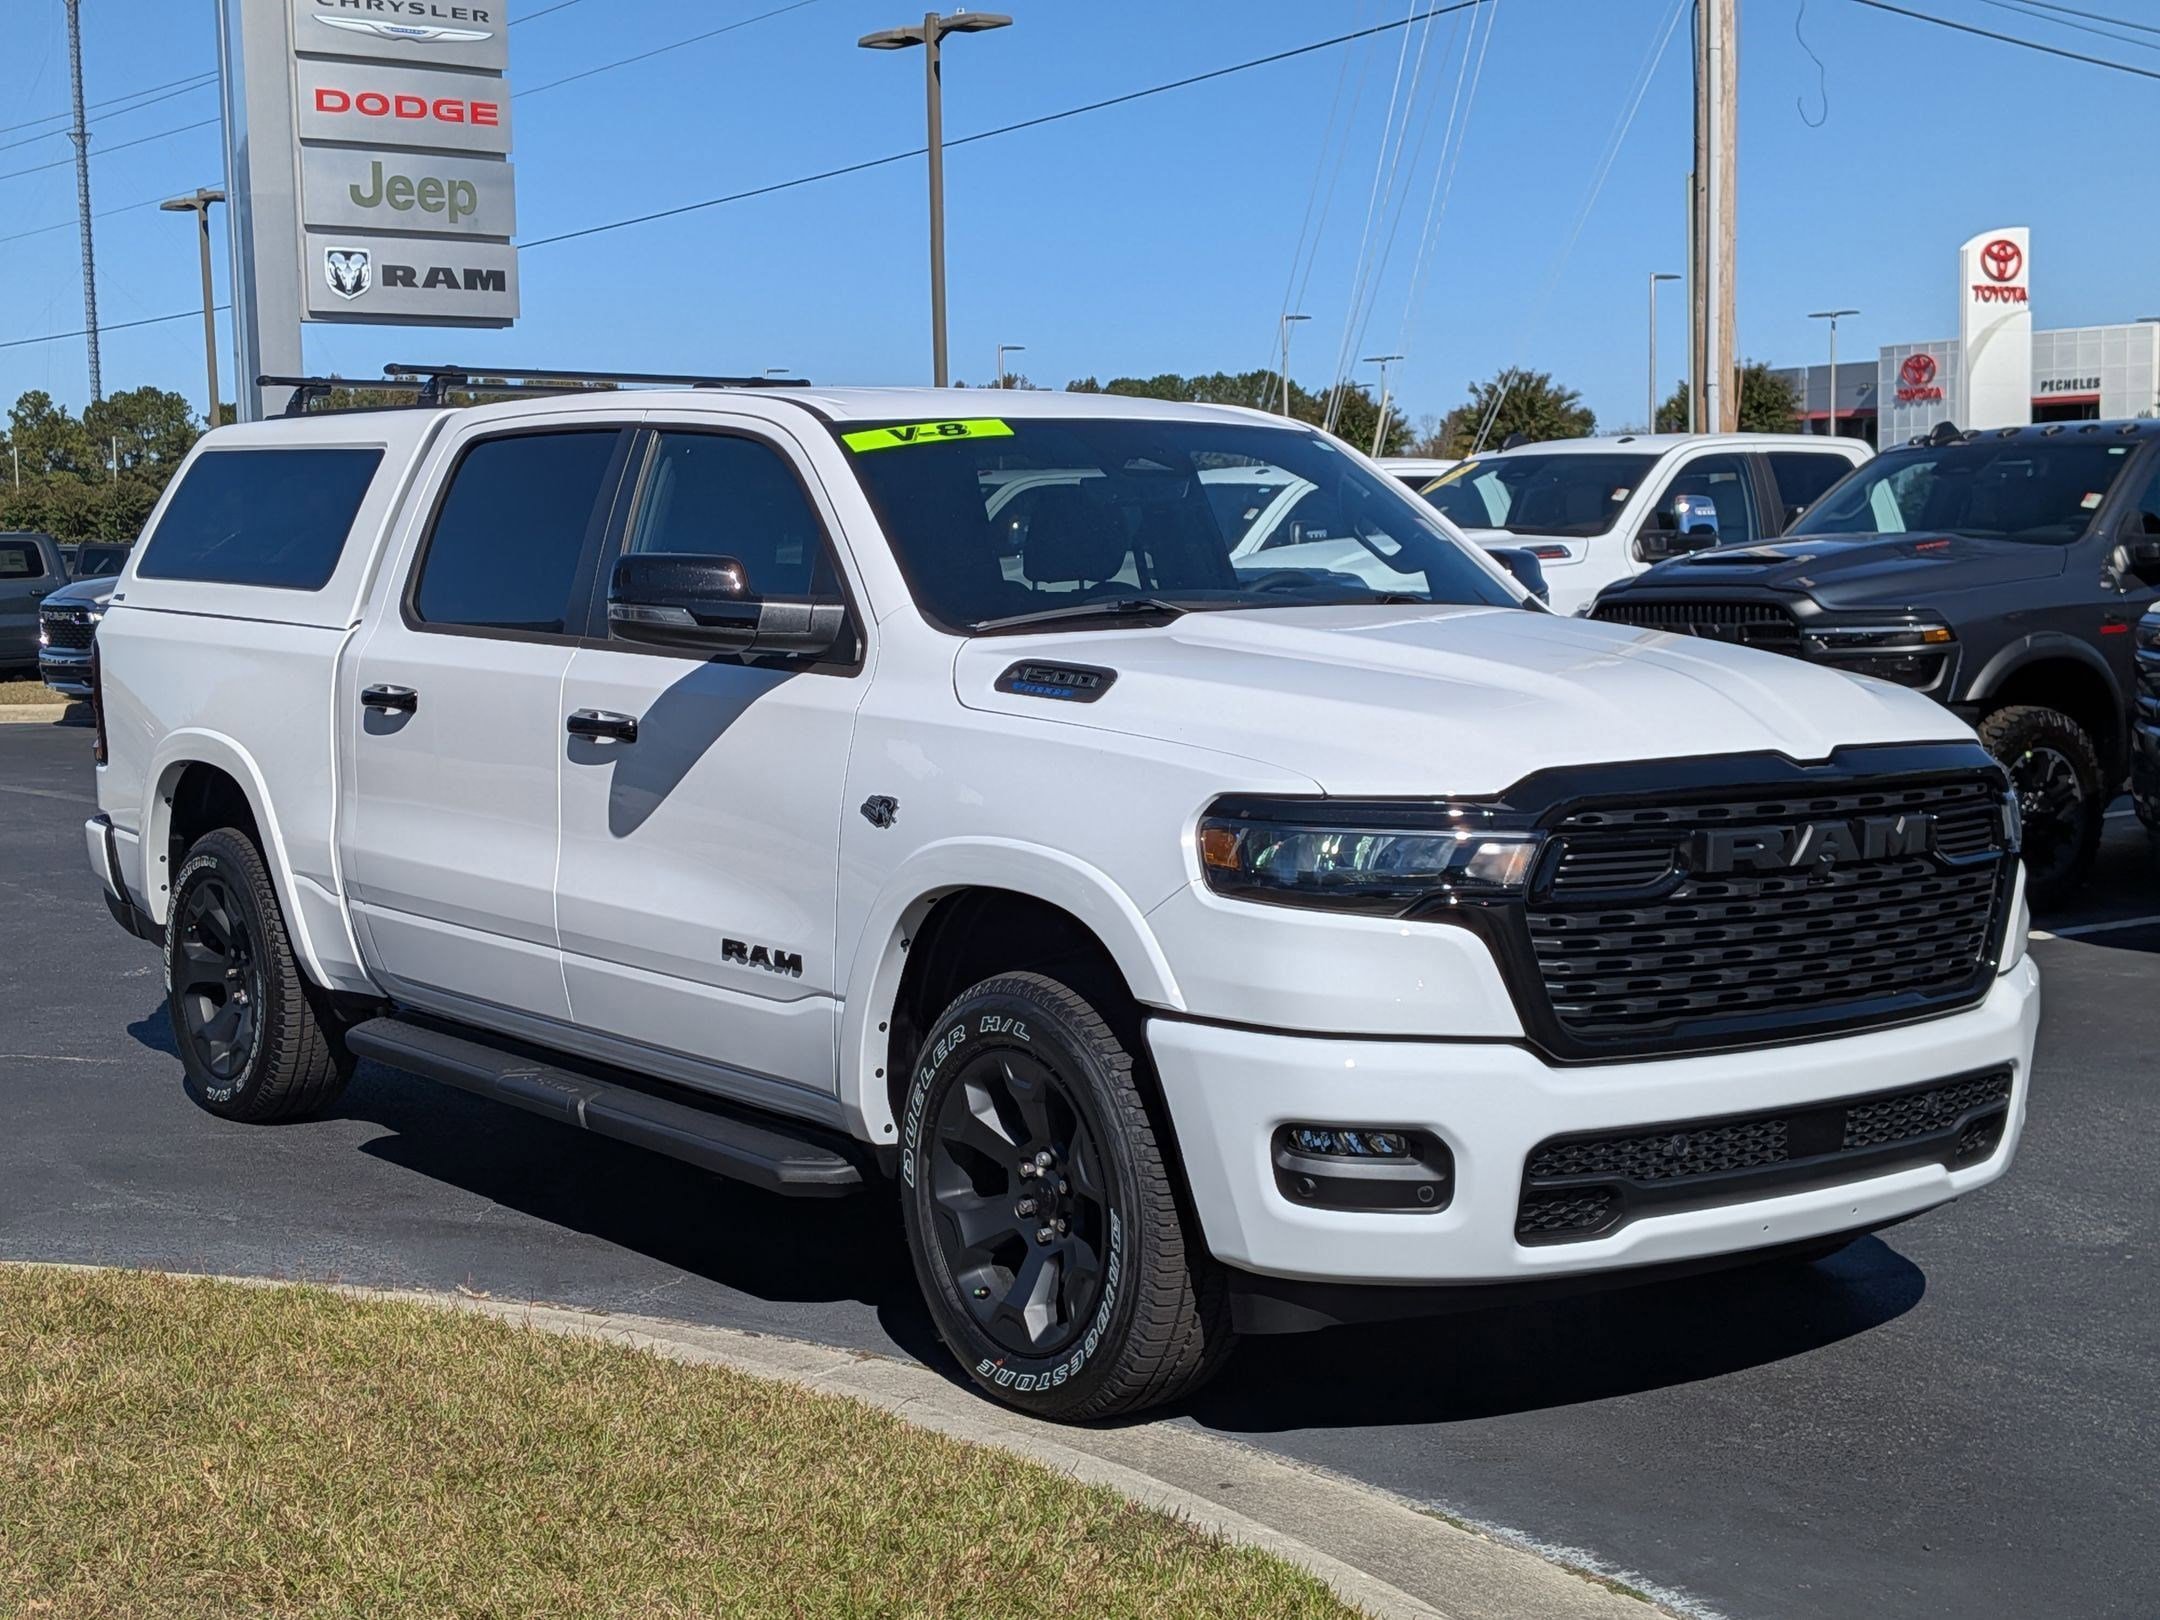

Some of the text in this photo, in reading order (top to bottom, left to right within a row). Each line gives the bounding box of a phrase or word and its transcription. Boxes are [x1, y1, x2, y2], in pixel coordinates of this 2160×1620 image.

[314, 88, 499, 127] DODGE
[349, 160, 478, 224] Jeep
[381, 264, 506, 292] RAM
[1972, 284, 2028, 304] TOYOTA
[1897, 386, 1942, 401] TOYOTA
[2040, 377, 2100, 392] PECHELES
[886, 422, 972, 442] V-8
[1022, 666, 1100, 689] 1500
[1702, 814, 1928, 873] RAM
[721, 937, 803, 978] RAM
[903, 1015, 1031, 1188] DUELER H/L
[975, 1207, 1121, 1392] BRIDGESTONE
